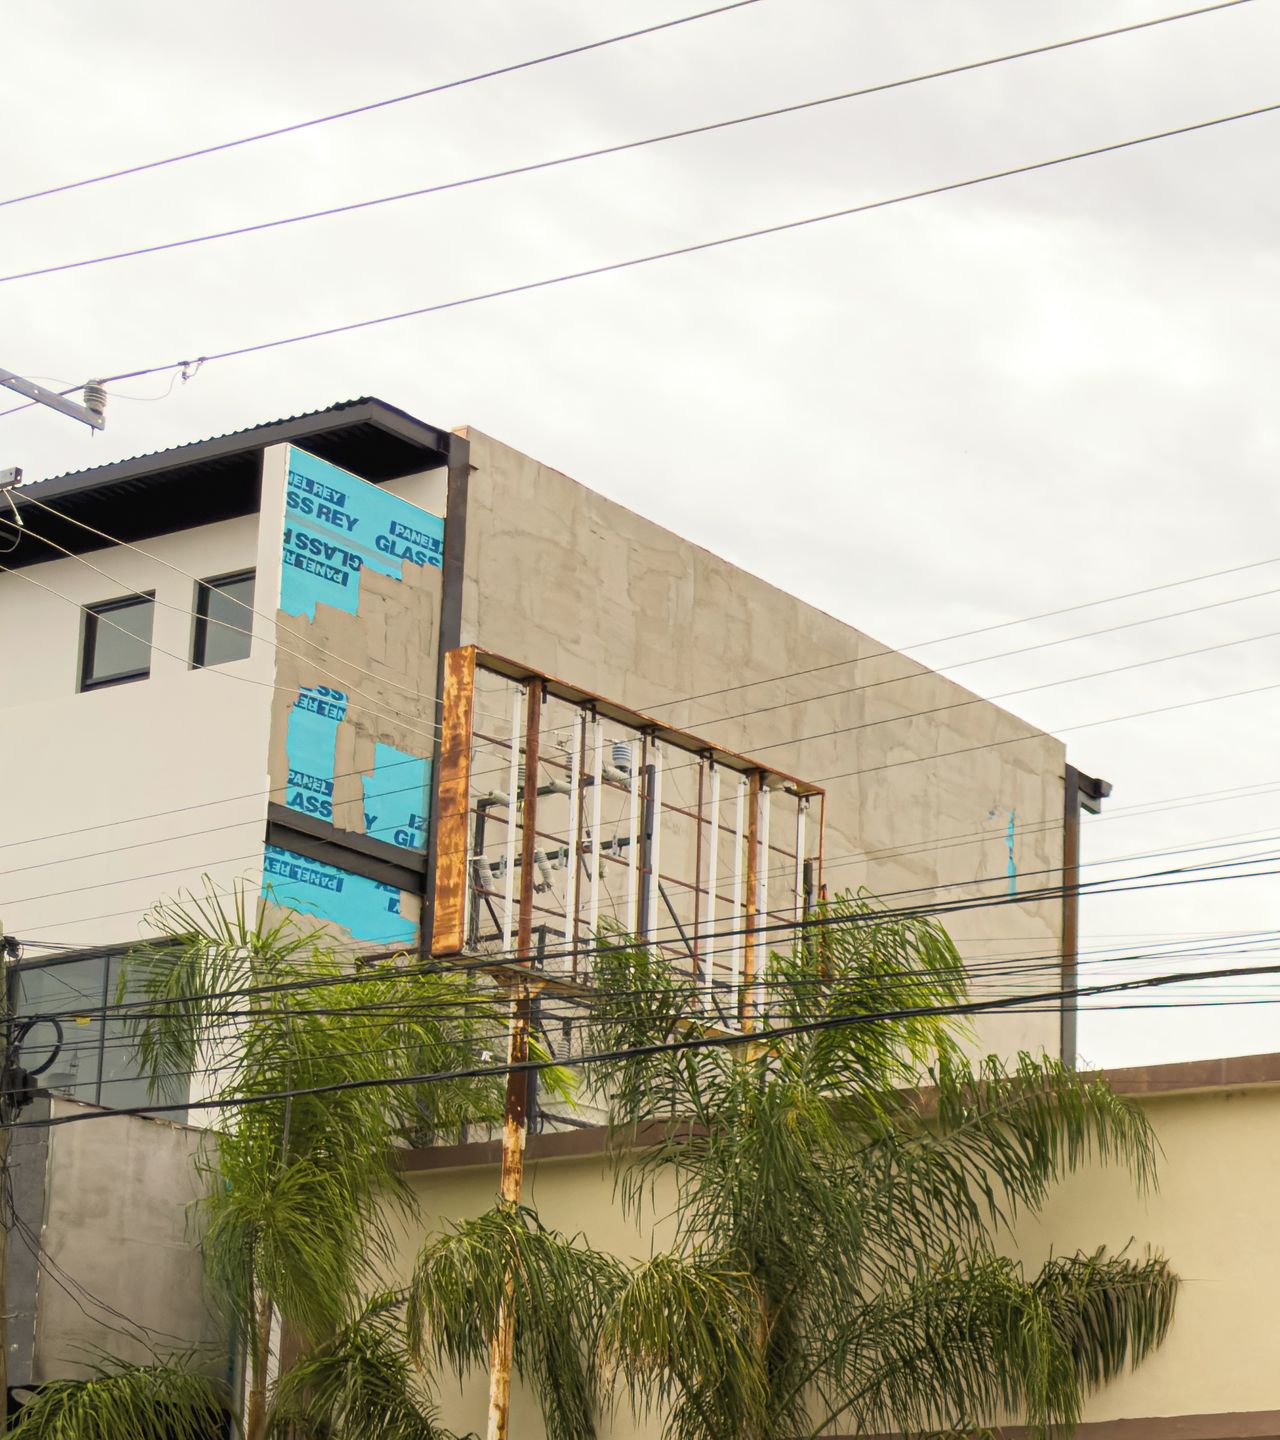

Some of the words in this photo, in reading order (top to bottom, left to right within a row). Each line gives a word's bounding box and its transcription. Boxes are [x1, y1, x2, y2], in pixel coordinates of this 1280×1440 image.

[313, 481, 341, 503] REY
[316, 503, 359, 532] REY
[394, 523, 437, 551] PANEL
[295, 532, 364, 572] GLASS
[299, 555, 343, 584] PANEL
